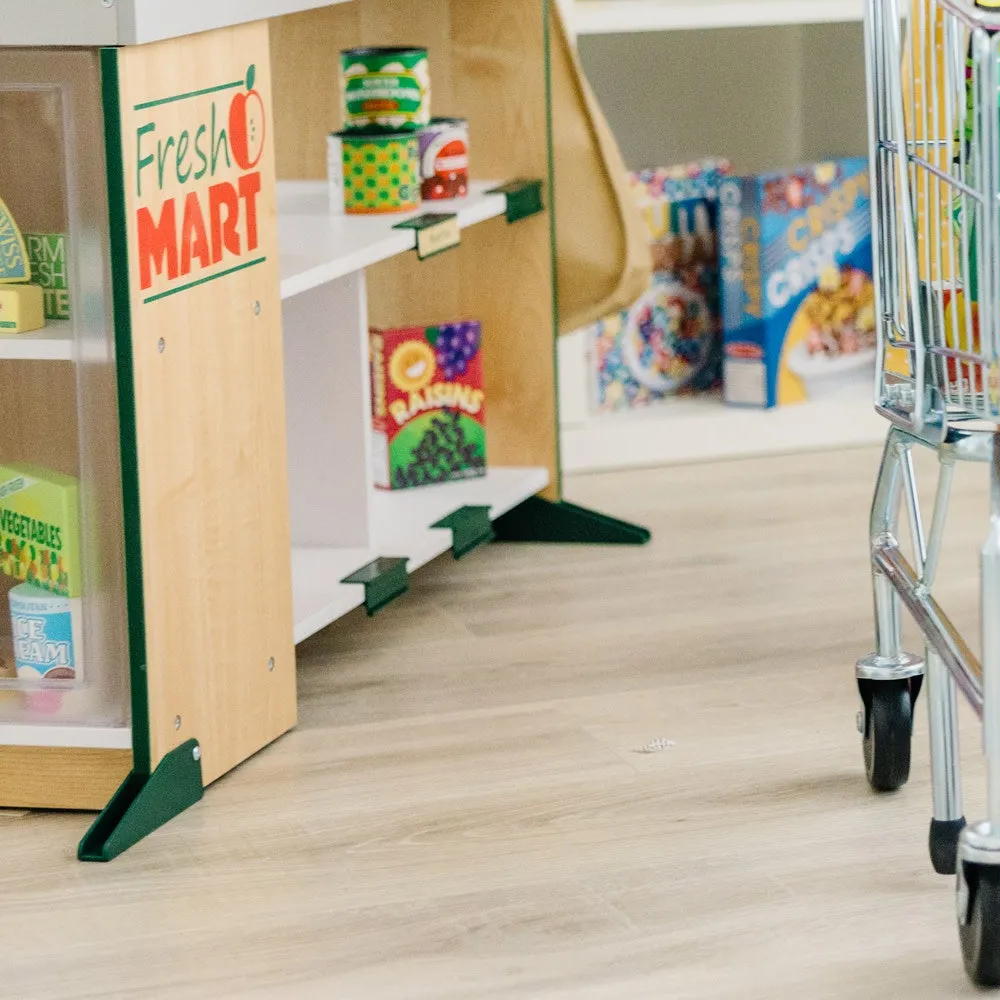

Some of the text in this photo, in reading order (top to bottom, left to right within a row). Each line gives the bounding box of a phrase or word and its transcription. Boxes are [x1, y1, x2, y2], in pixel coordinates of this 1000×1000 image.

[136, 101, 231, 197] Fresh
[136, 171, 261, 291] MART
[15, 639, 70, 666] EAM
